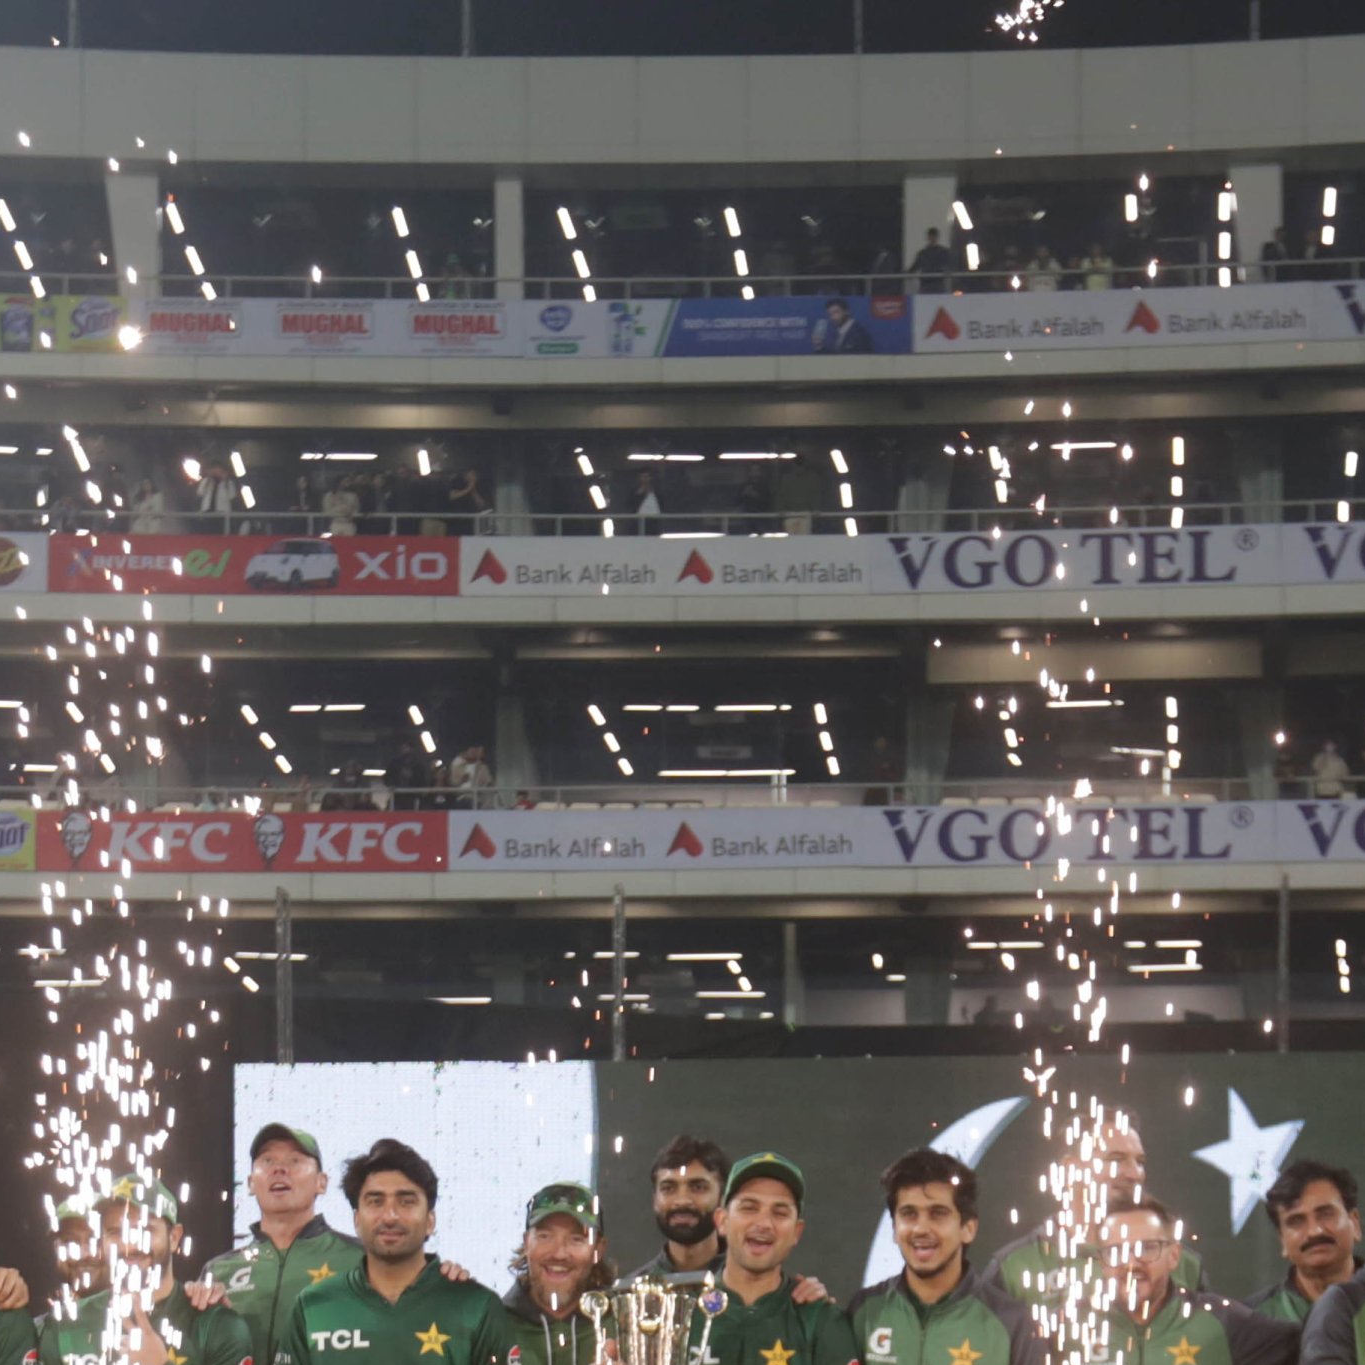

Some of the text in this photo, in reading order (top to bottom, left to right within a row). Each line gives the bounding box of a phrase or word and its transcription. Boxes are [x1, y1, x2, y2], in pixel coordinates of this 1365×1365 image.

[150, 312, 235, 333] MUGHAL
[282, 313, 369, 334] MUGHAL
[414, 314, 501, 334] MUGHAL
[967, 320, 1022, 339] Bank
[889, 531, 1237, 590] VGO TEL
[516, 562, 656, 584] Bank Alfalah
[723, 561, 863, 583] Bank Alfalah
[107, 821, 231, 863] KFC
[294, 821, 423, 863] KFC
[883, 806, 1232, 863] VGO TEL
[505, 837, 645, 858] Bank Alflah
[712, 835, 853, 858] Bank Alfalah
[311, 1329, 370, 1351] TCL
